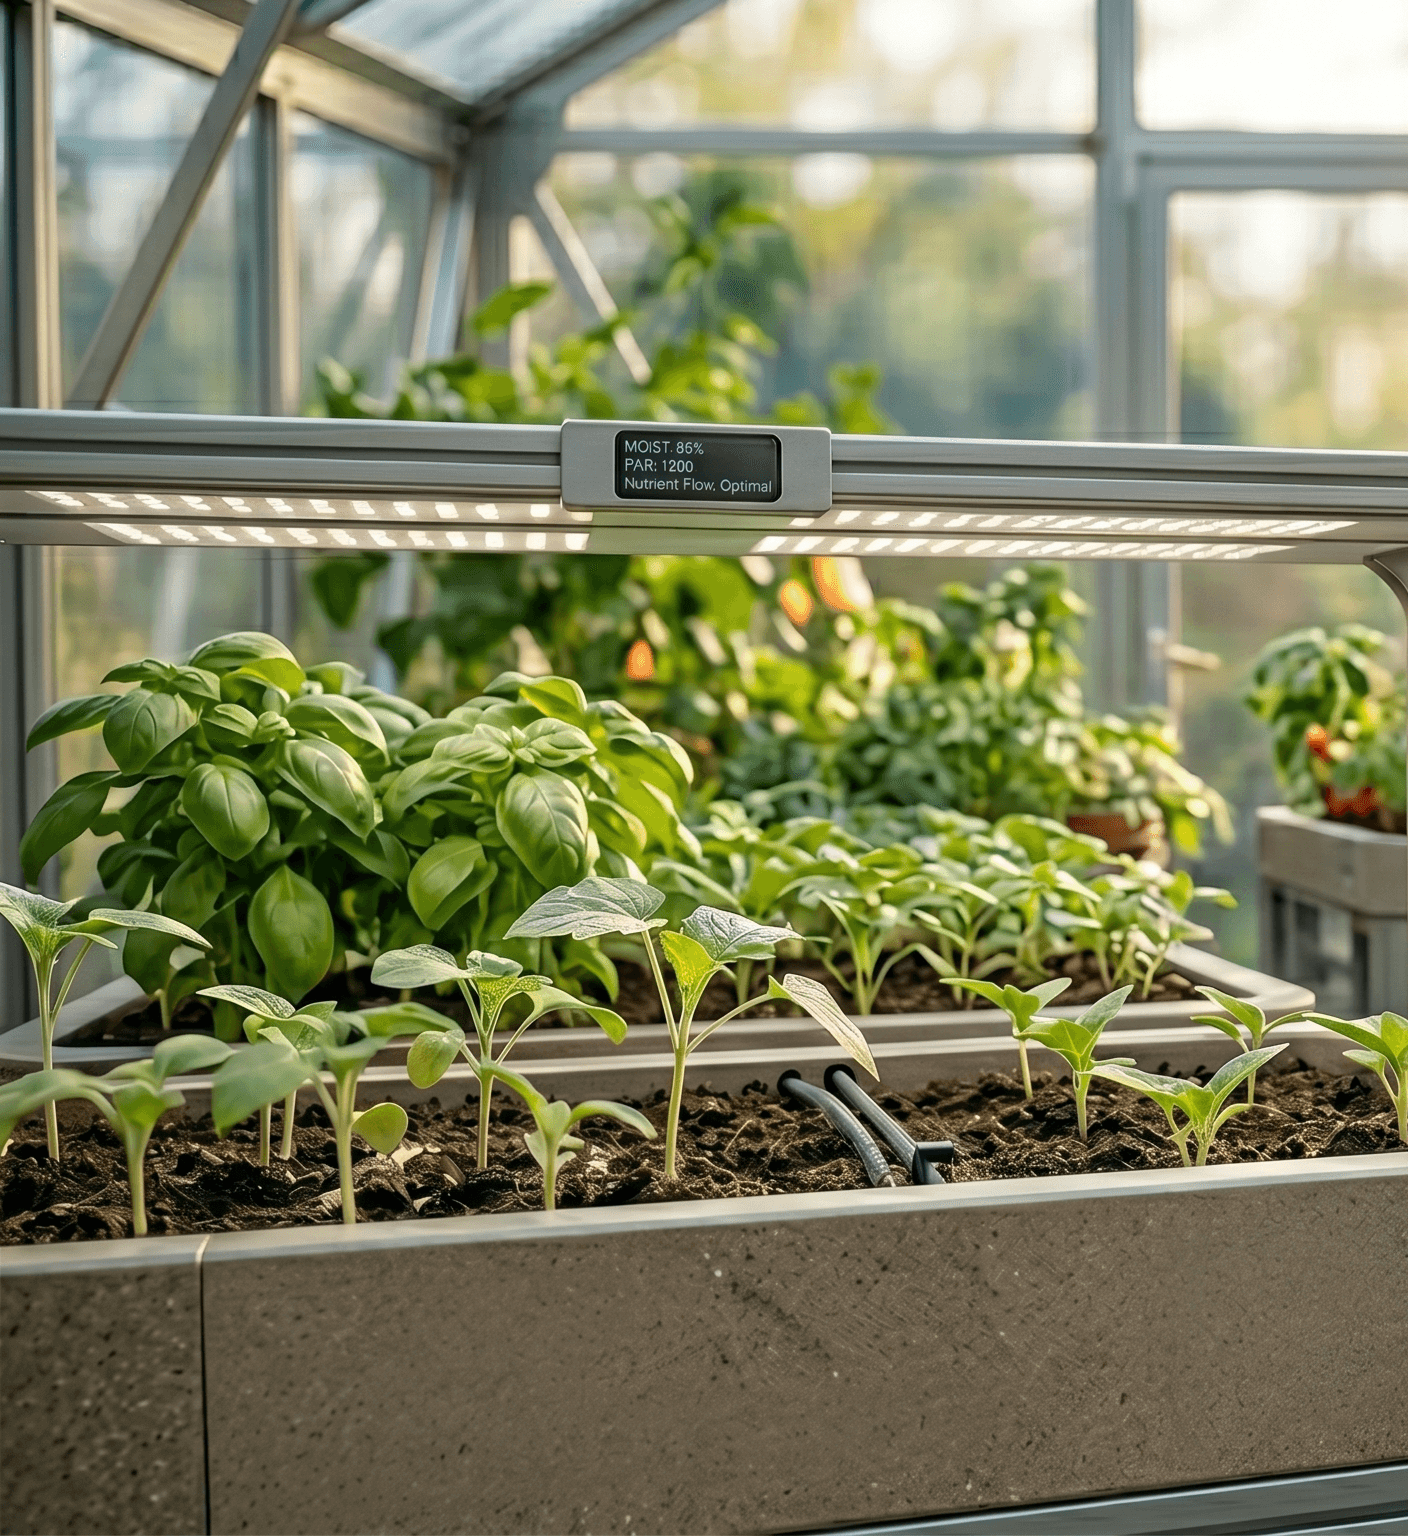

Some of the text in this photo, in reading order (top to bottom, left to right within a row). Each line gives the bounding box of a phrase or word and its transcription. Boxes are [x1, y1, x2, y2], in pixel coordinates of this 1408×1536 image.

[676, 441, 704, 455] 86%
[624, 458, 694, 473] PAR: 1200
[624, 477, 679, 491] Nutrient
[720, 479, 772, 495] Optimal
